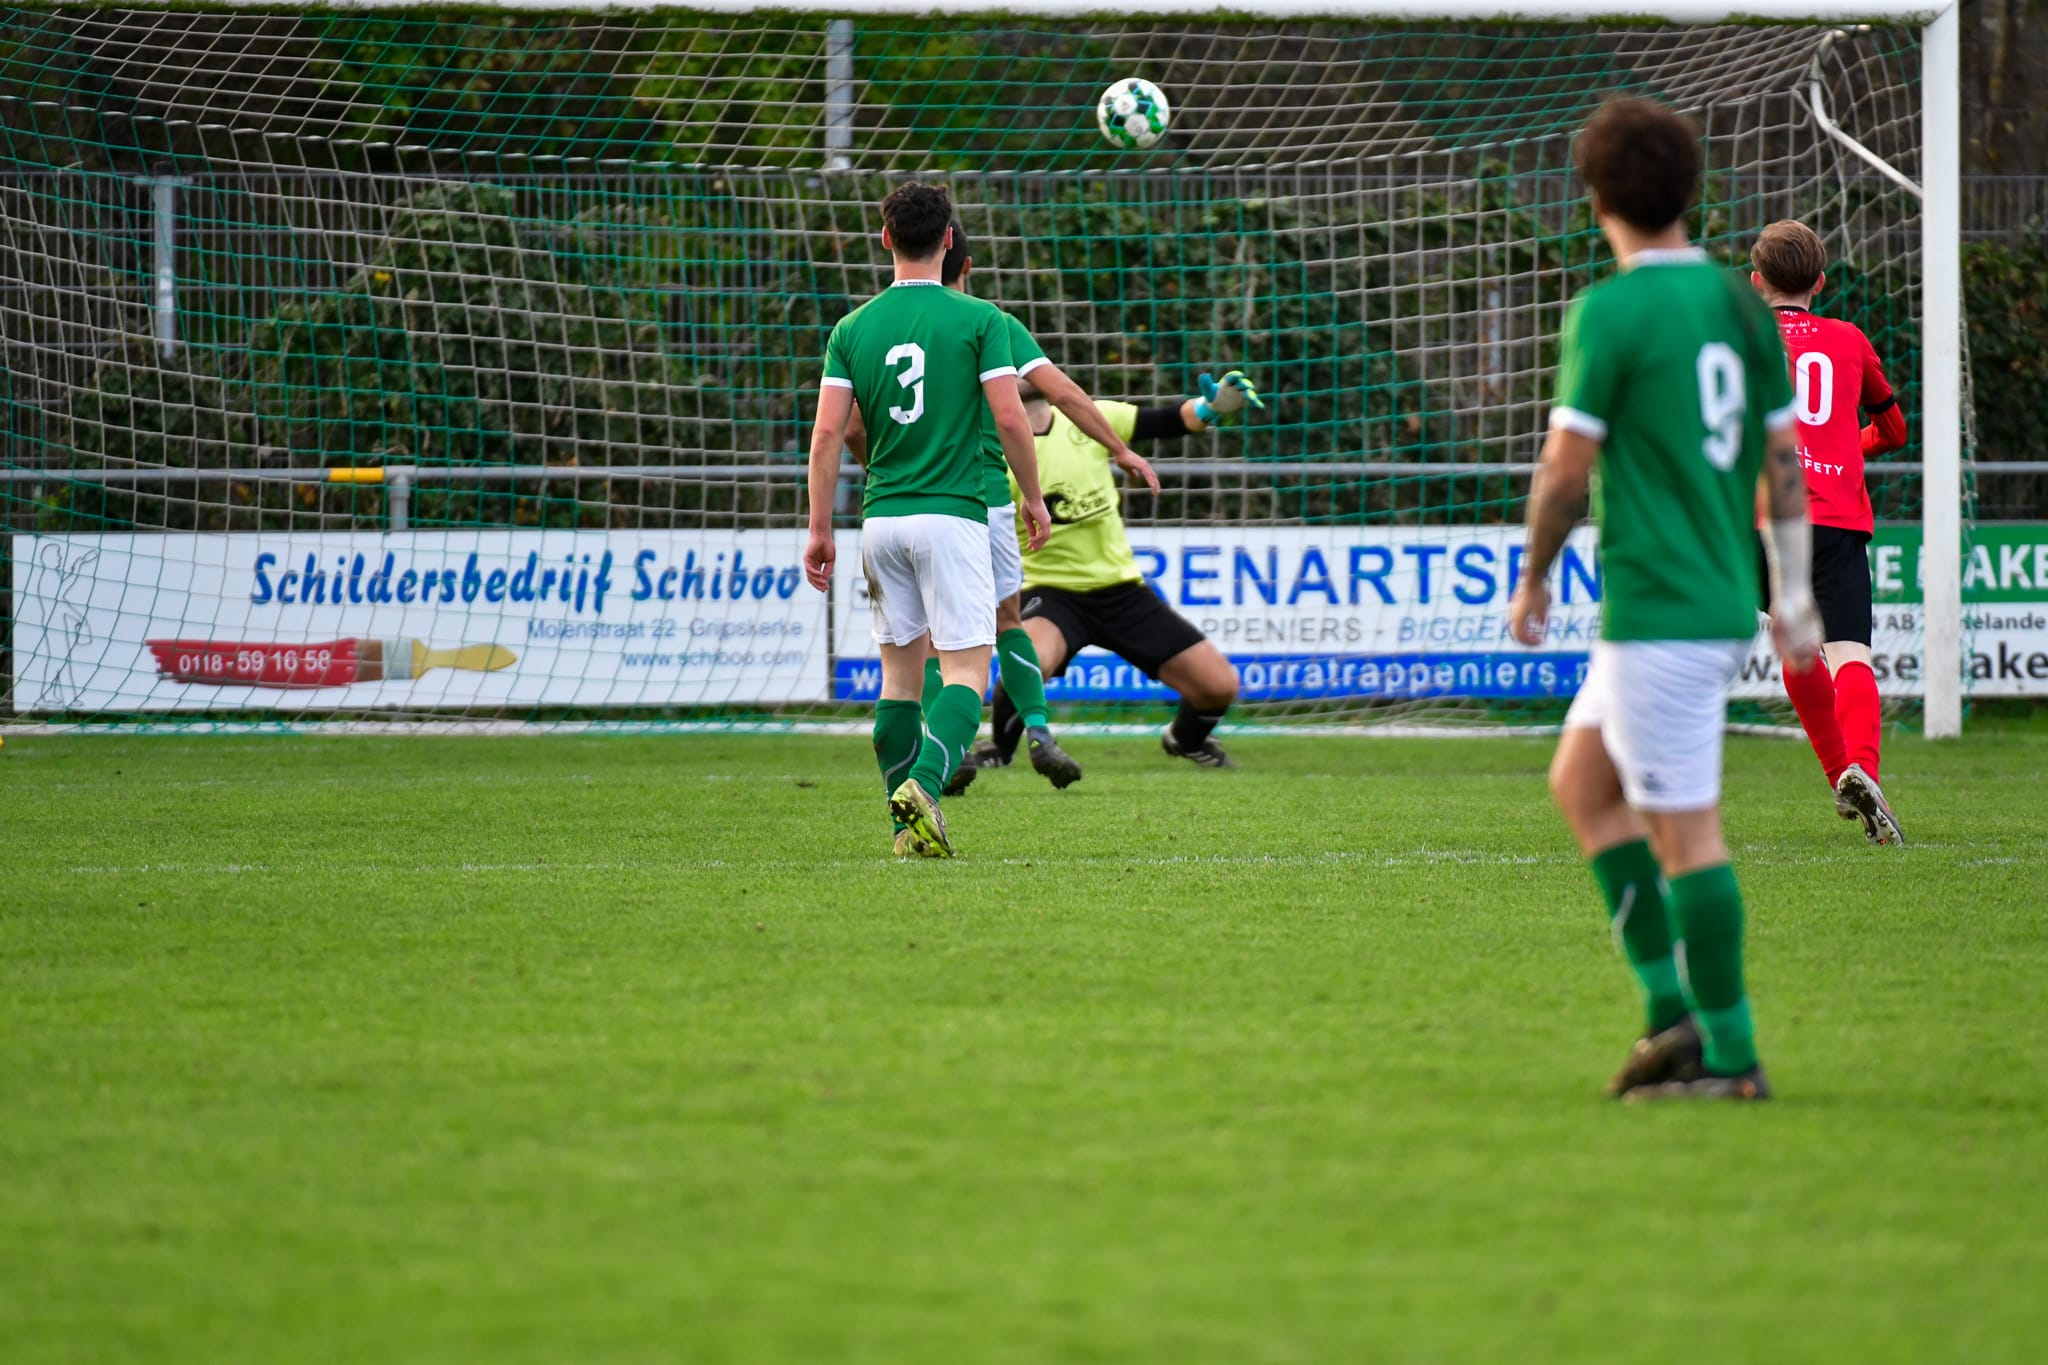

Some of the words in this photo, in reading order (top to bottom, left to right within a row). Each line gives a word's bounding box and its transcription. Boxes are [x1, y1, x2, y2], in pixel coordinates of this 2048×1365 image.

[885, 343, 925, 424] 3
[1696, 342, 1746, 471] 9
[1784, 351, 1833, 426] 0
[252, 549, 613, 614] Schildersbedrijf
[631, 549, 801, 601] Schiboo
[304, 650, 331, 670] 58
[527, 618, 645, 638] Molenstraat
[651, 619, 675, 637] 22
[690, 617, 804, 640] Grijpskerke
[1202, 617, 1362, 642] PPENIERS
